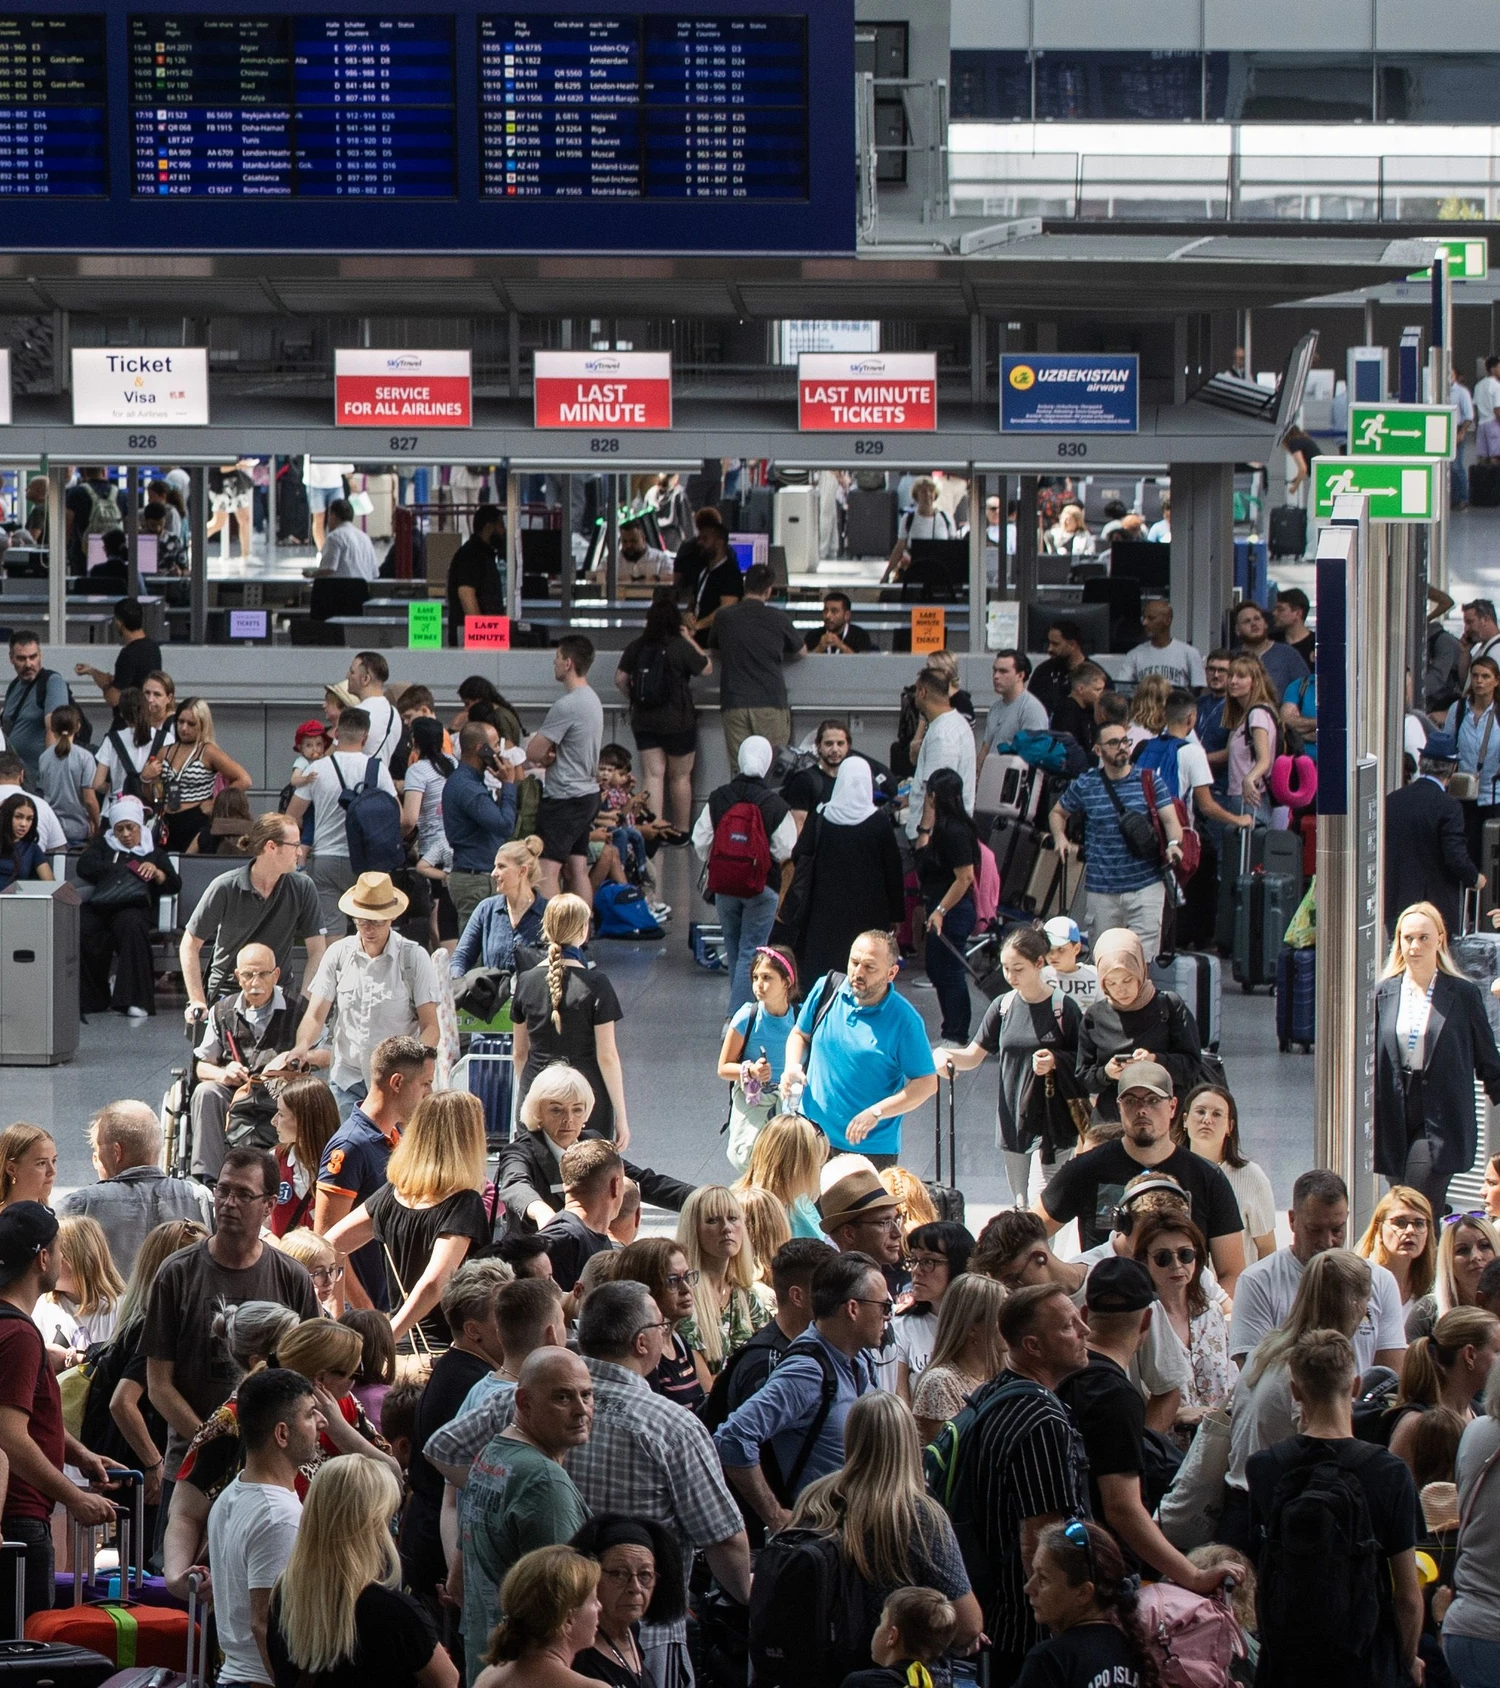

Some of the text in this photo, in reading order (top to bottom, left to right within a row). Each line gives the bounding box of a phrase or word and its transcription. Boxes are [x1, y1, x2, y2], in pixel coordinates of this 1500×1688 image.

[107, 356, 171, 372] Ticket
[134, 377, 144, 387] &
[1038, 369, 1129, 383] UZBEKISTAN
[375, 387, 430, 401] SERVICE
[577, 384, 627, 403] LAST
[1087, 383, 1125, 392] airways
[124, 392, 155, 403] Visa
[805, 387, 930, 404] LAST MINUTE
[345, 402, 462, 416] FOR ALL AIRLINES
[559, 403, 646, 422] MINUTE
[831, 407, 905, 423] TICKETS
[128, 435, 157, 448] 826
[390, 437, 418, 450] 827
[591, 439, 619, 452] 828
[855, 440, 883, 455] 829
[1058, 443, 1087, 456] 830
[1046, 980, 1096, 994] SURF
